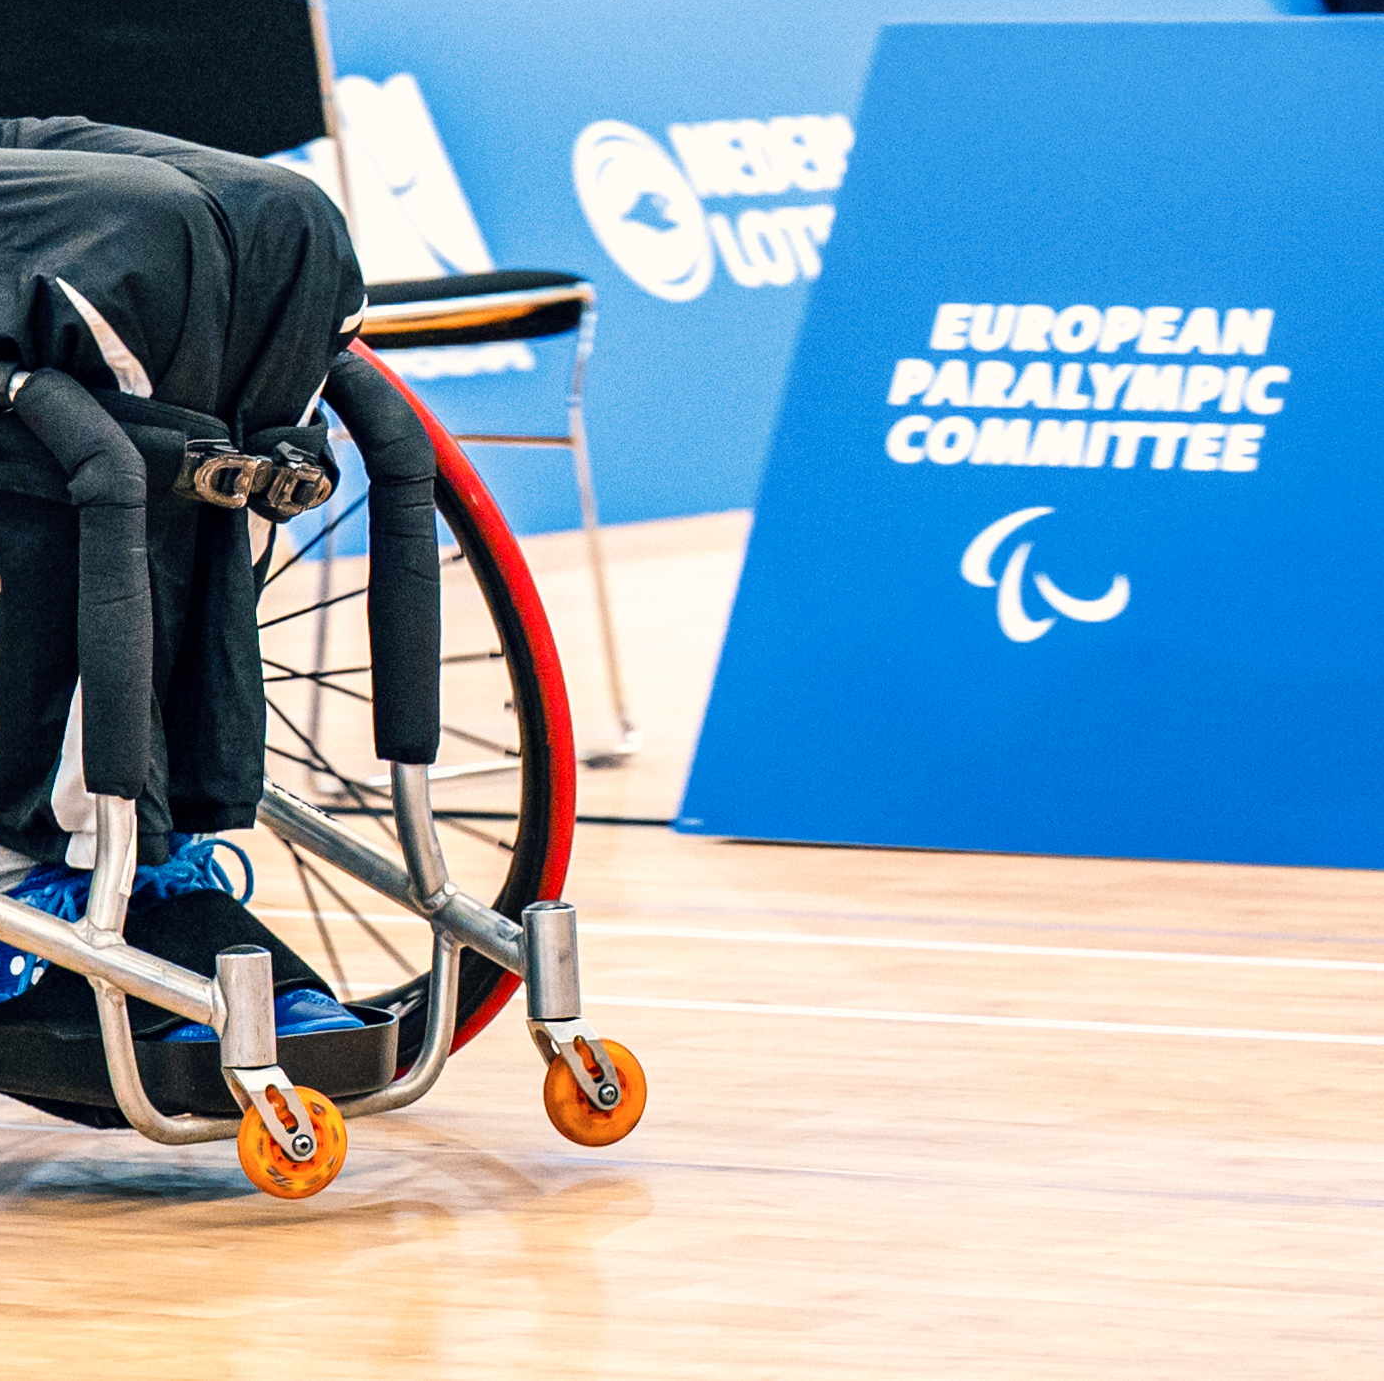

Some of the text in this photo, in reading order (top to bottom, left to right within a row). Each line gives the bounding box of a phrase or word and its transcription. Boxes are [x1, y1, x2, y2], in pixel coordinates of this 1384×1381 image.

[930, 303, 1275, 356] EUROPEAN
[886, 358, 1291, 415] PARALYMPIC
[885, 415, 1266, 472] COMMITTEE
